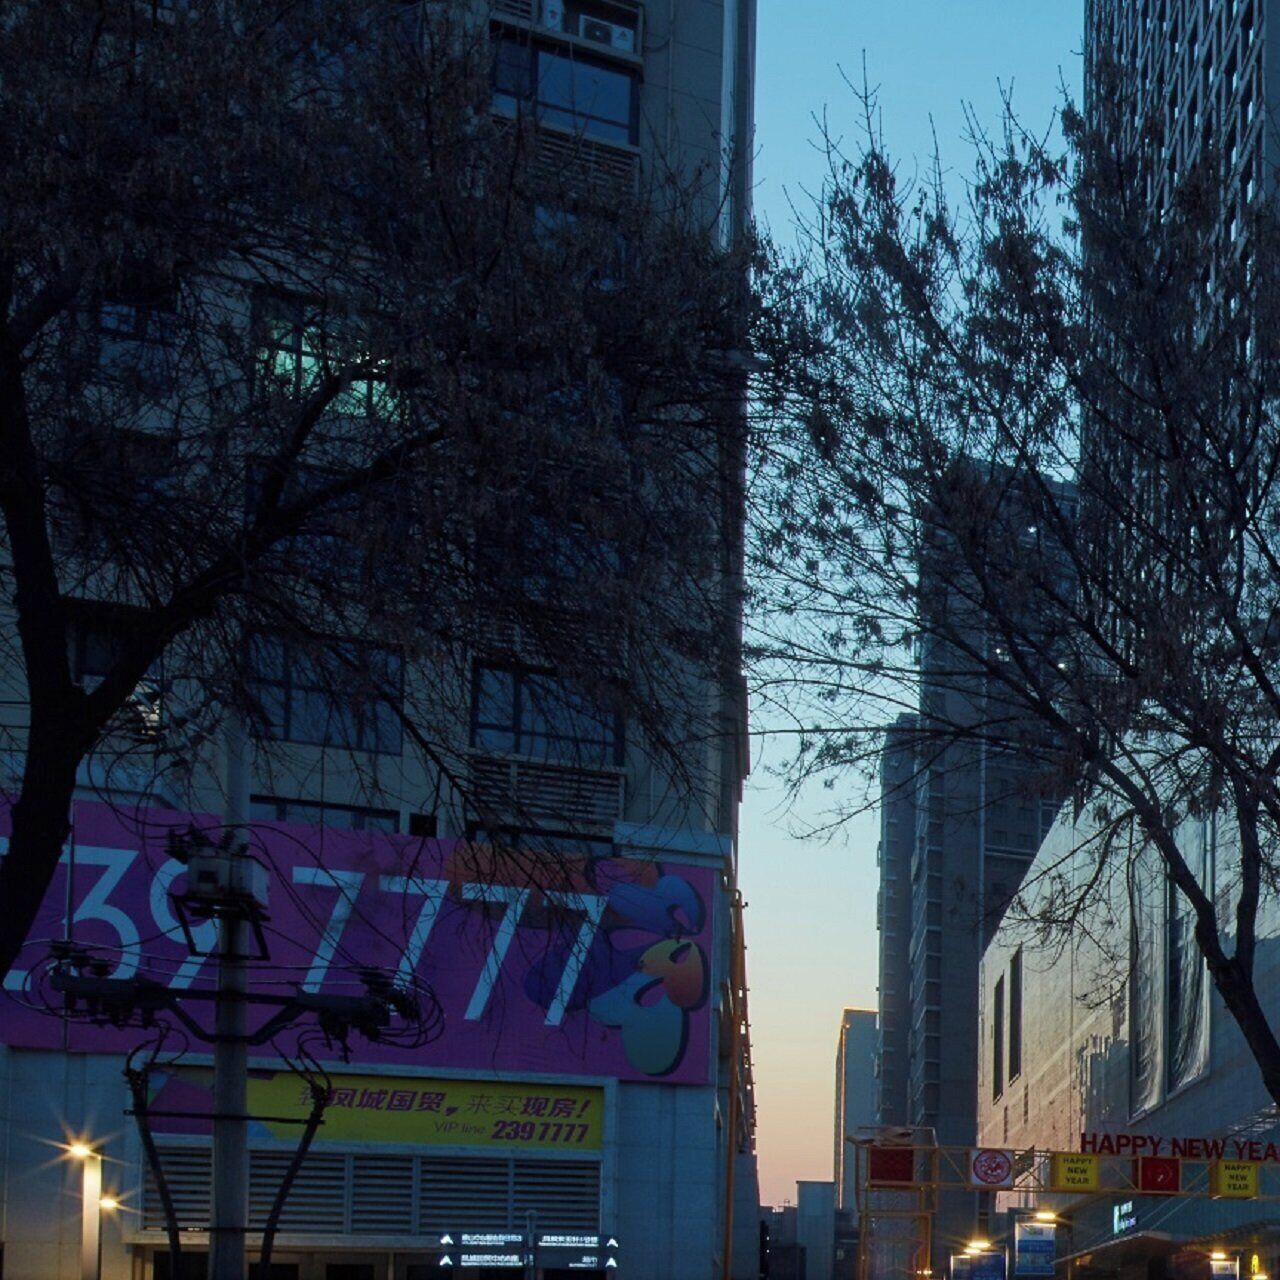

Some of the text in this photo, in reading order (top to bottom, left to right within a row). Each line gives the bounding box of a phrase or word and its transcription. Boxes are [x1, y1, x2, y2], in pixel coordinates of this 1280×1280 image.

[434, 1121, 459, 1133] VIP
[1081, 1133, 1164, 1156] HAPPY
[1172, 1137, 1226, 1160] NEW
[1067, 1166, 1089, 1174] NEW
